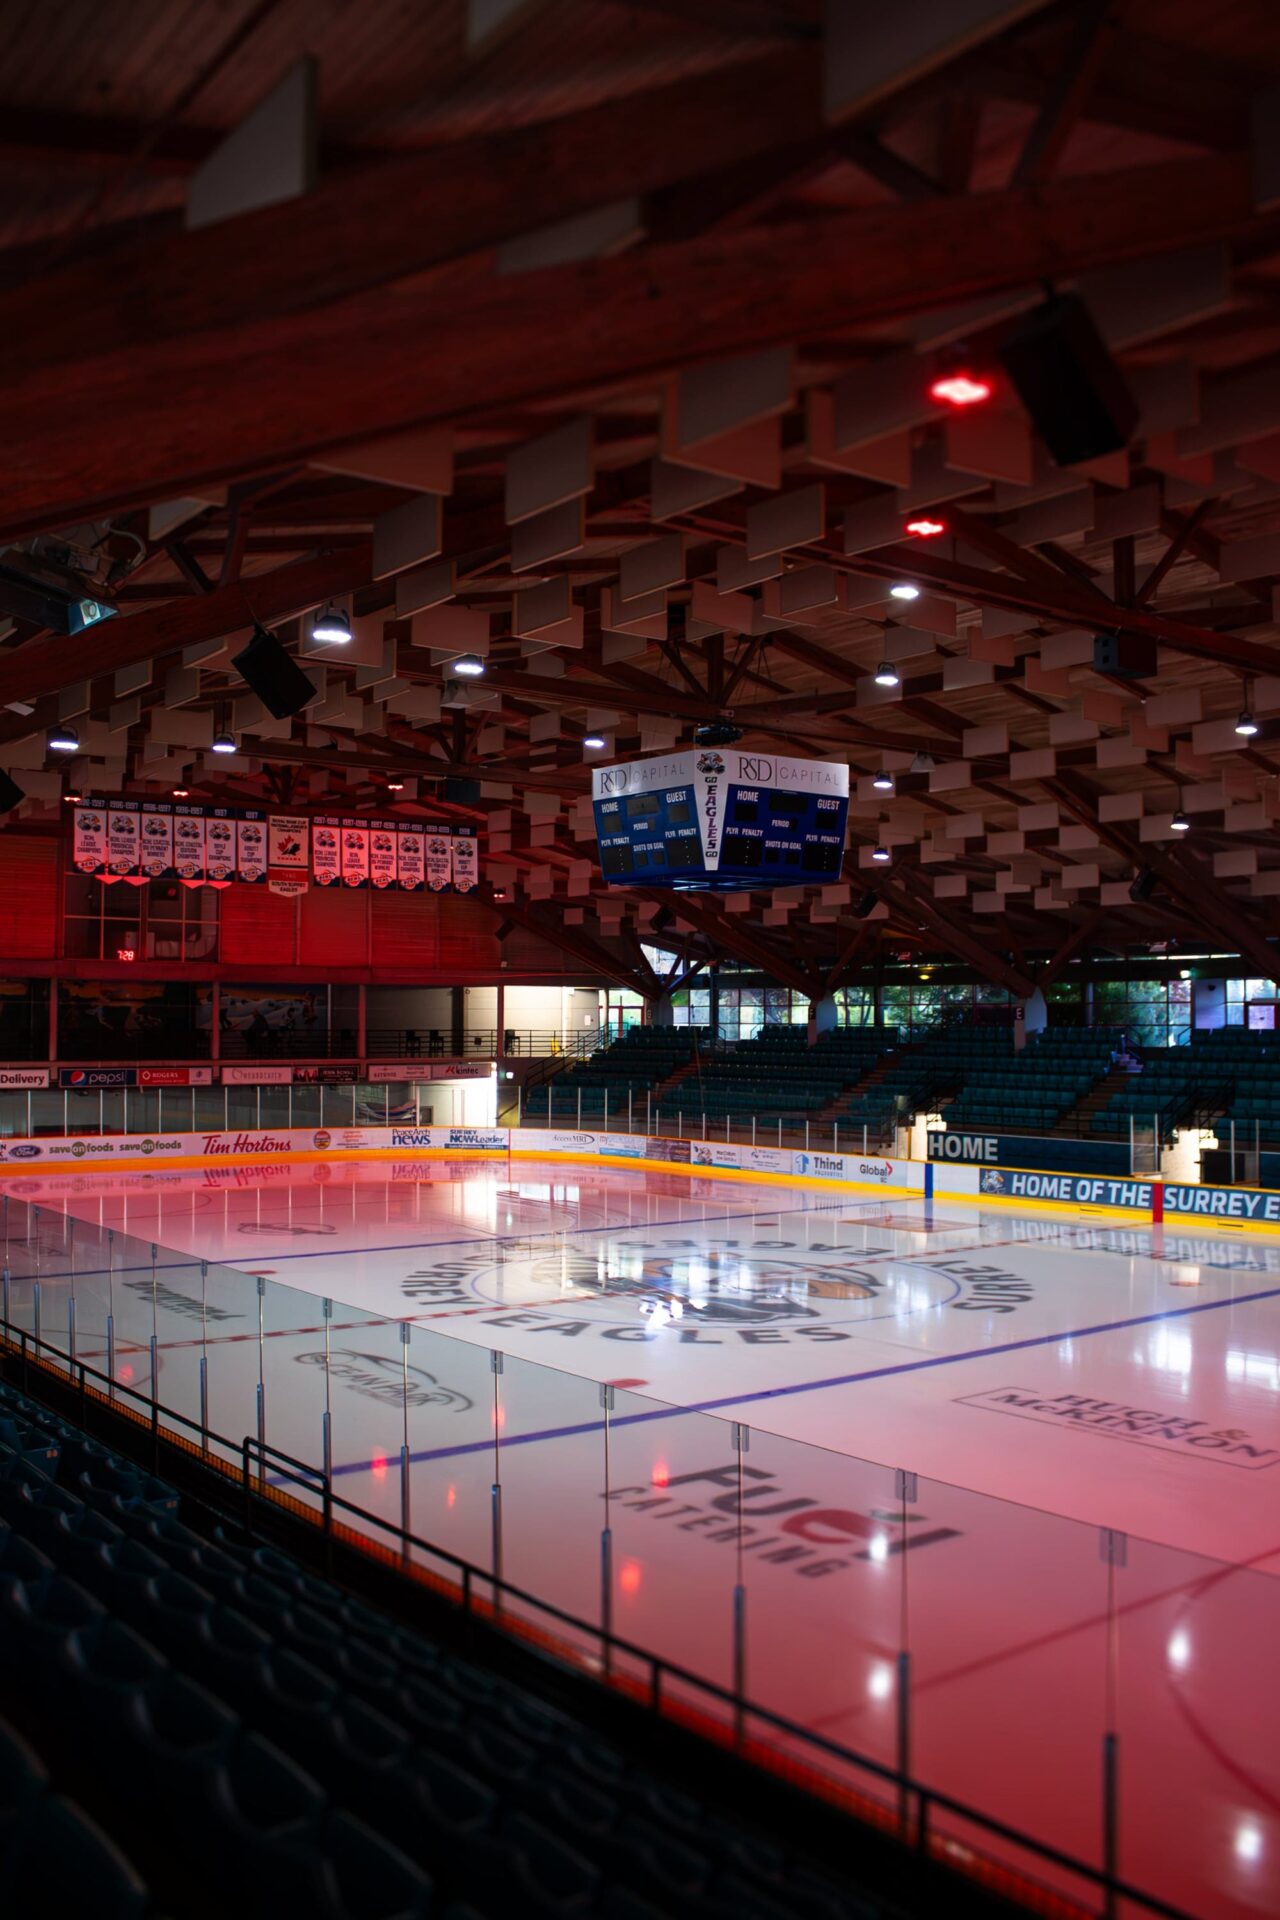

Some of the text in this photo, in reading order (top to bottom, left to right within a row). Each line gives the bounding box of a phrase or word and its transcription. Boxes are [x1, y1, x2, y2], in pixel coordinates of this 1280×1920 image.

[738, 757, 839, 785] RSD CAPITAL
[600, 764, 685, 794] RSD CAPITAL
[666, 790, 686, 803] GUEST
[737, 790, 759, 802] HOME
[601, 802, 618, 813] HOME
[817, 799, 840, 810] GUEST
[706, 785, 717, 850] EAGLES
[678, 828, 696, 837] PENALTY
[742, 828, 764, 837] PENALTY
[820, 835, 840, 844] PENALTY
[0, 1074, 45, 1085] Delivery
[89, 1071, 125, 1084] pepsi
[202, 1133, 291, 1154] Tim Hortons
[392, 1135, 430, 1145] news
[928, 1135, 998, 1161] HOME
[814, 1157, 843, 1171] Thind
[860, 1164, 888, 1176] Global
[1012, 1174, 1072, 1199] HOME
[1076, 1179, 1104, 1202] OF
[1108, 1182, 1150, 1207] THE
[1164, 1187, 1261, 1217] SURREY
[481, 1313, 853, 1346] EAGLES
[1049, 1394, 1208, 1430] HUGH
[989, 1394, 1278, 1458] McKINNON
[600, 1486, 853, 1578] CATERING
